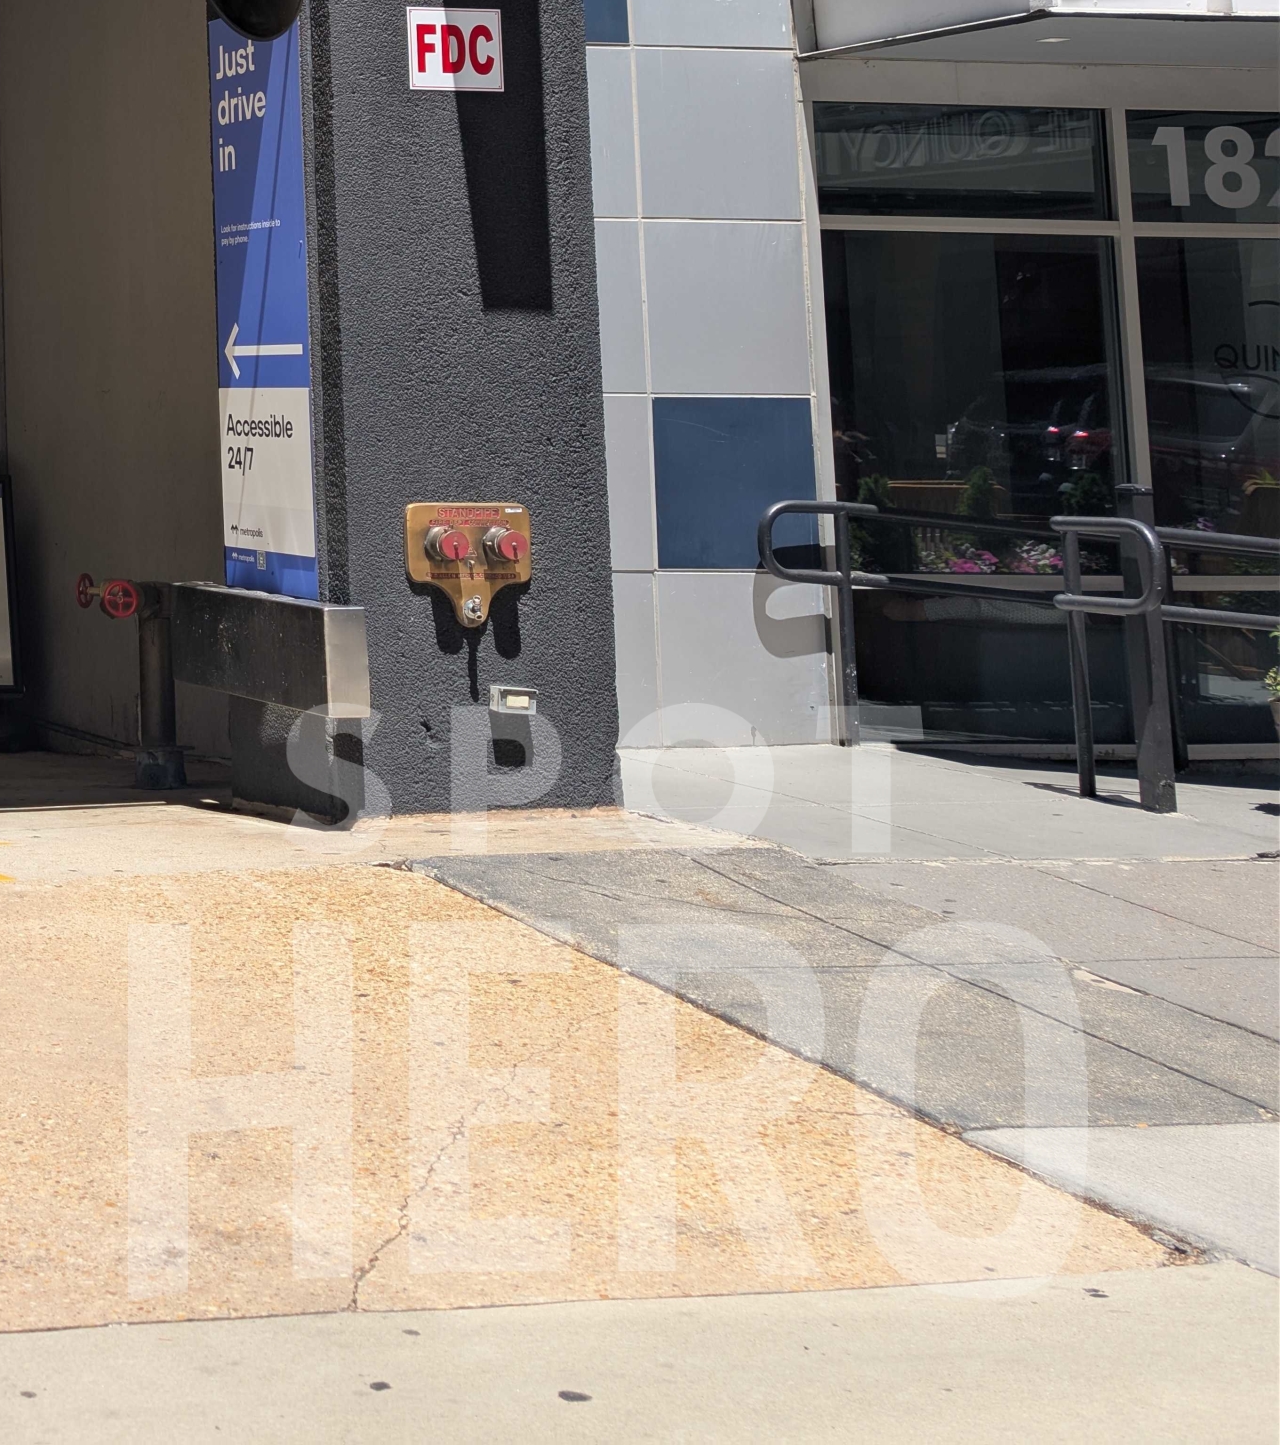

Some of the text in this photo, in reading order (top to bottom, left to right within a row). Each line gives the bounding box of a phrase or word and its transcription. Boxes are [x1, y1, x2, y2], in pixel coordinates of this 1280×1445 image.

[215, 39, 255, 80] Just
[416, 23, 495, 76] FDC
[217, 86, 267, 126] drive
[218, 137, 236, 172] in
[1151, 125, 1280, 210] 18
[220, 225, 231, 234] Look
[237, 221, 261, 231] instructions
[275, 219, 281, 227] to
[226, 413, 293, 439] Accessible
[227, 446, 254, 476] 24/7
[438, 508, 499, 518] STANDPIPE
[240, 526, 264, 539] metropolis
